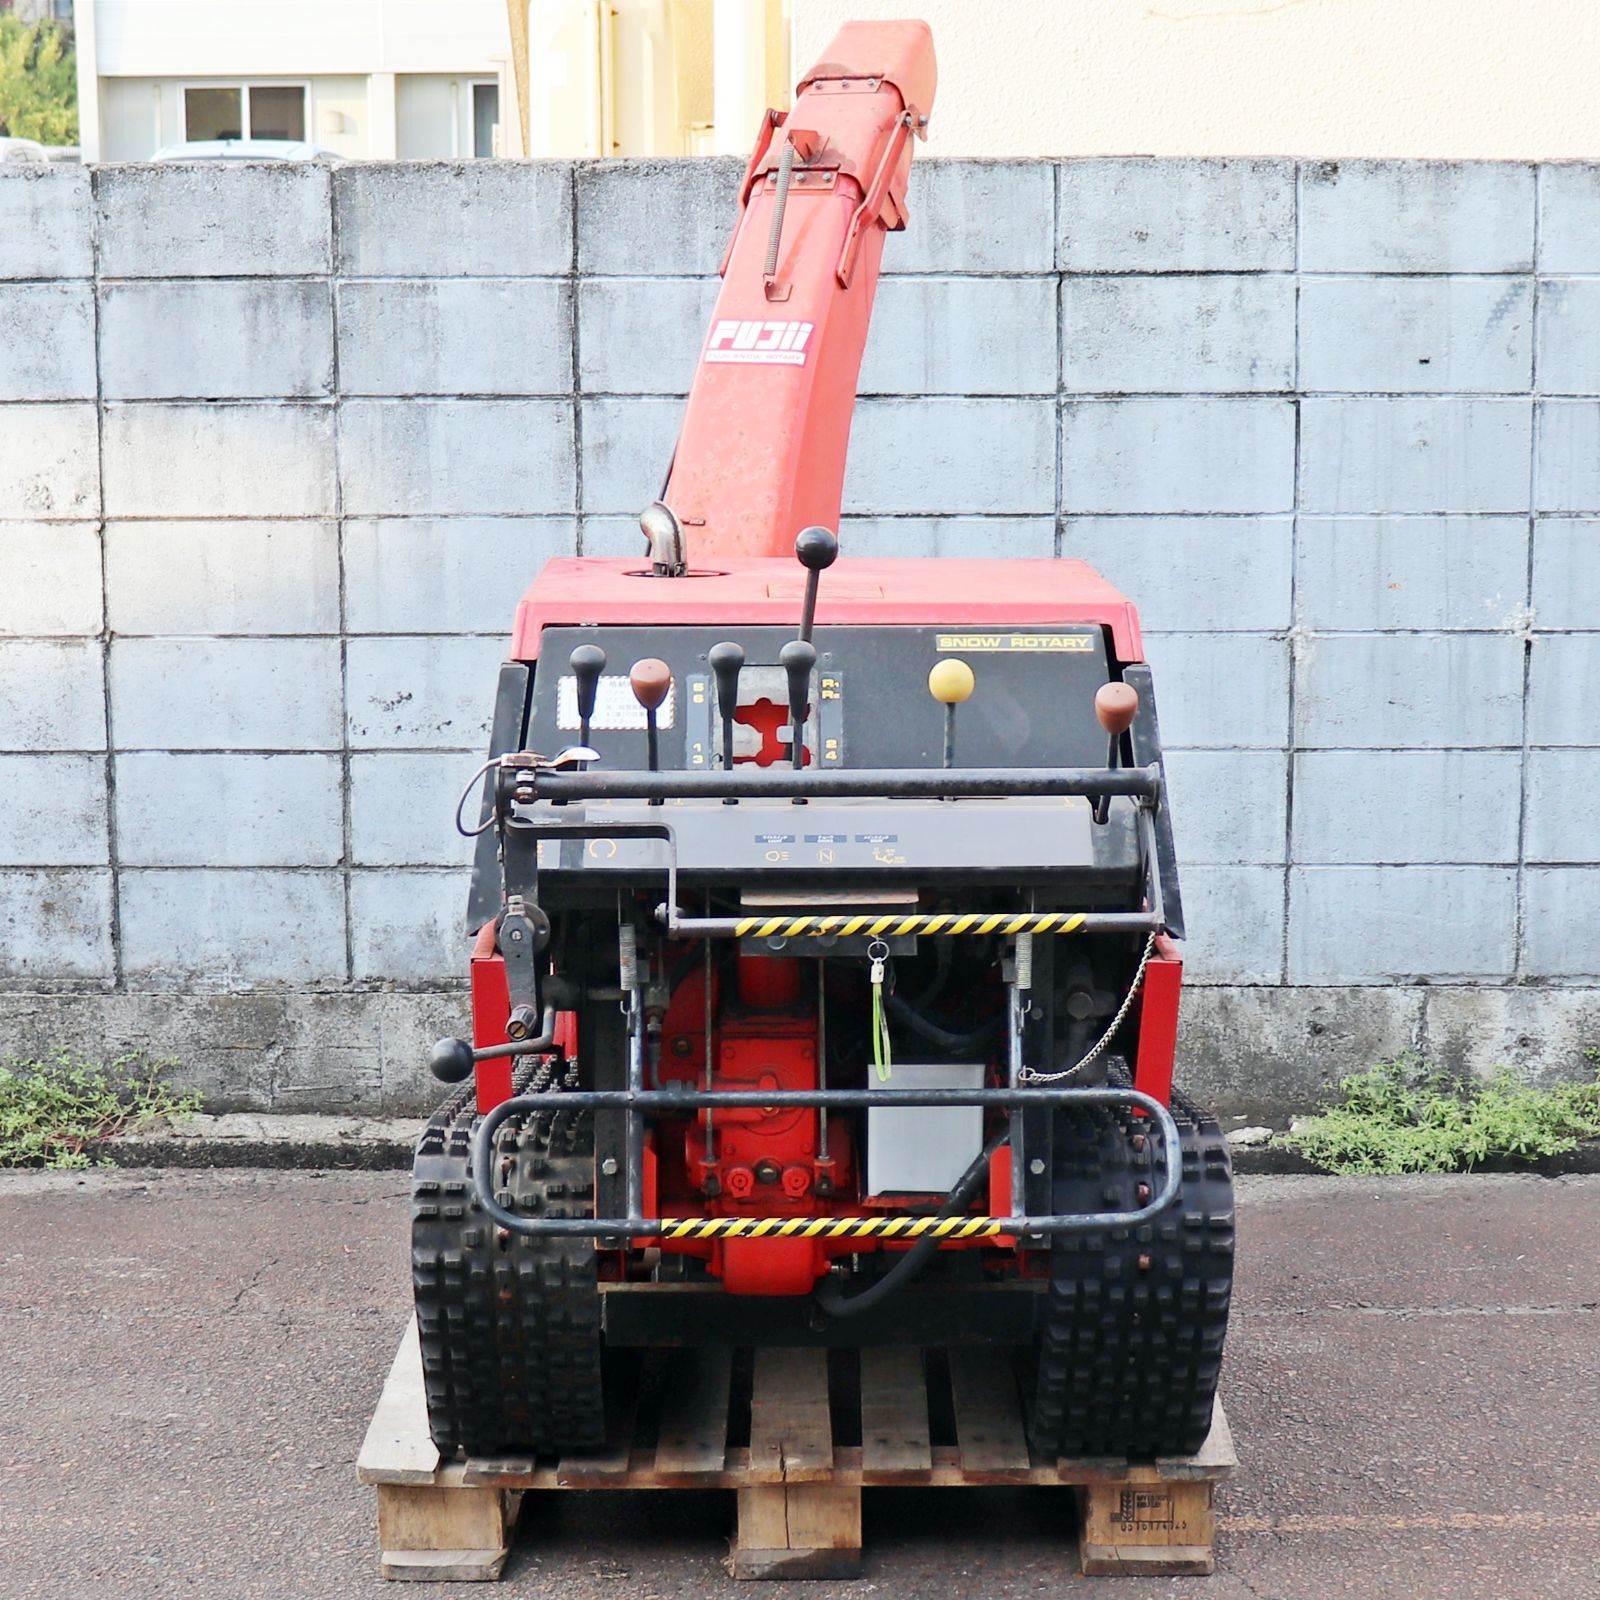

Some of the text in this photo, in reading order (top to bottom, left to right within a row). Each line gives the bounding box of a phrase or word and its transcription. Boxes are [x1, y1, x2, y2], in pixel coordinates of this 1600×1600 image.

[939, 637, 1089, 648] SNOW ROTARY
[692, 682, 704, 692] 5
[692, 694, 704, 704] 6
[692, 742, 702, 752] 1
[825, 739, 837, 749] 2
[692, 754, 704, 764] 3
[825, 750, 837, 761] 4
[819, 849, 833, 863] N
